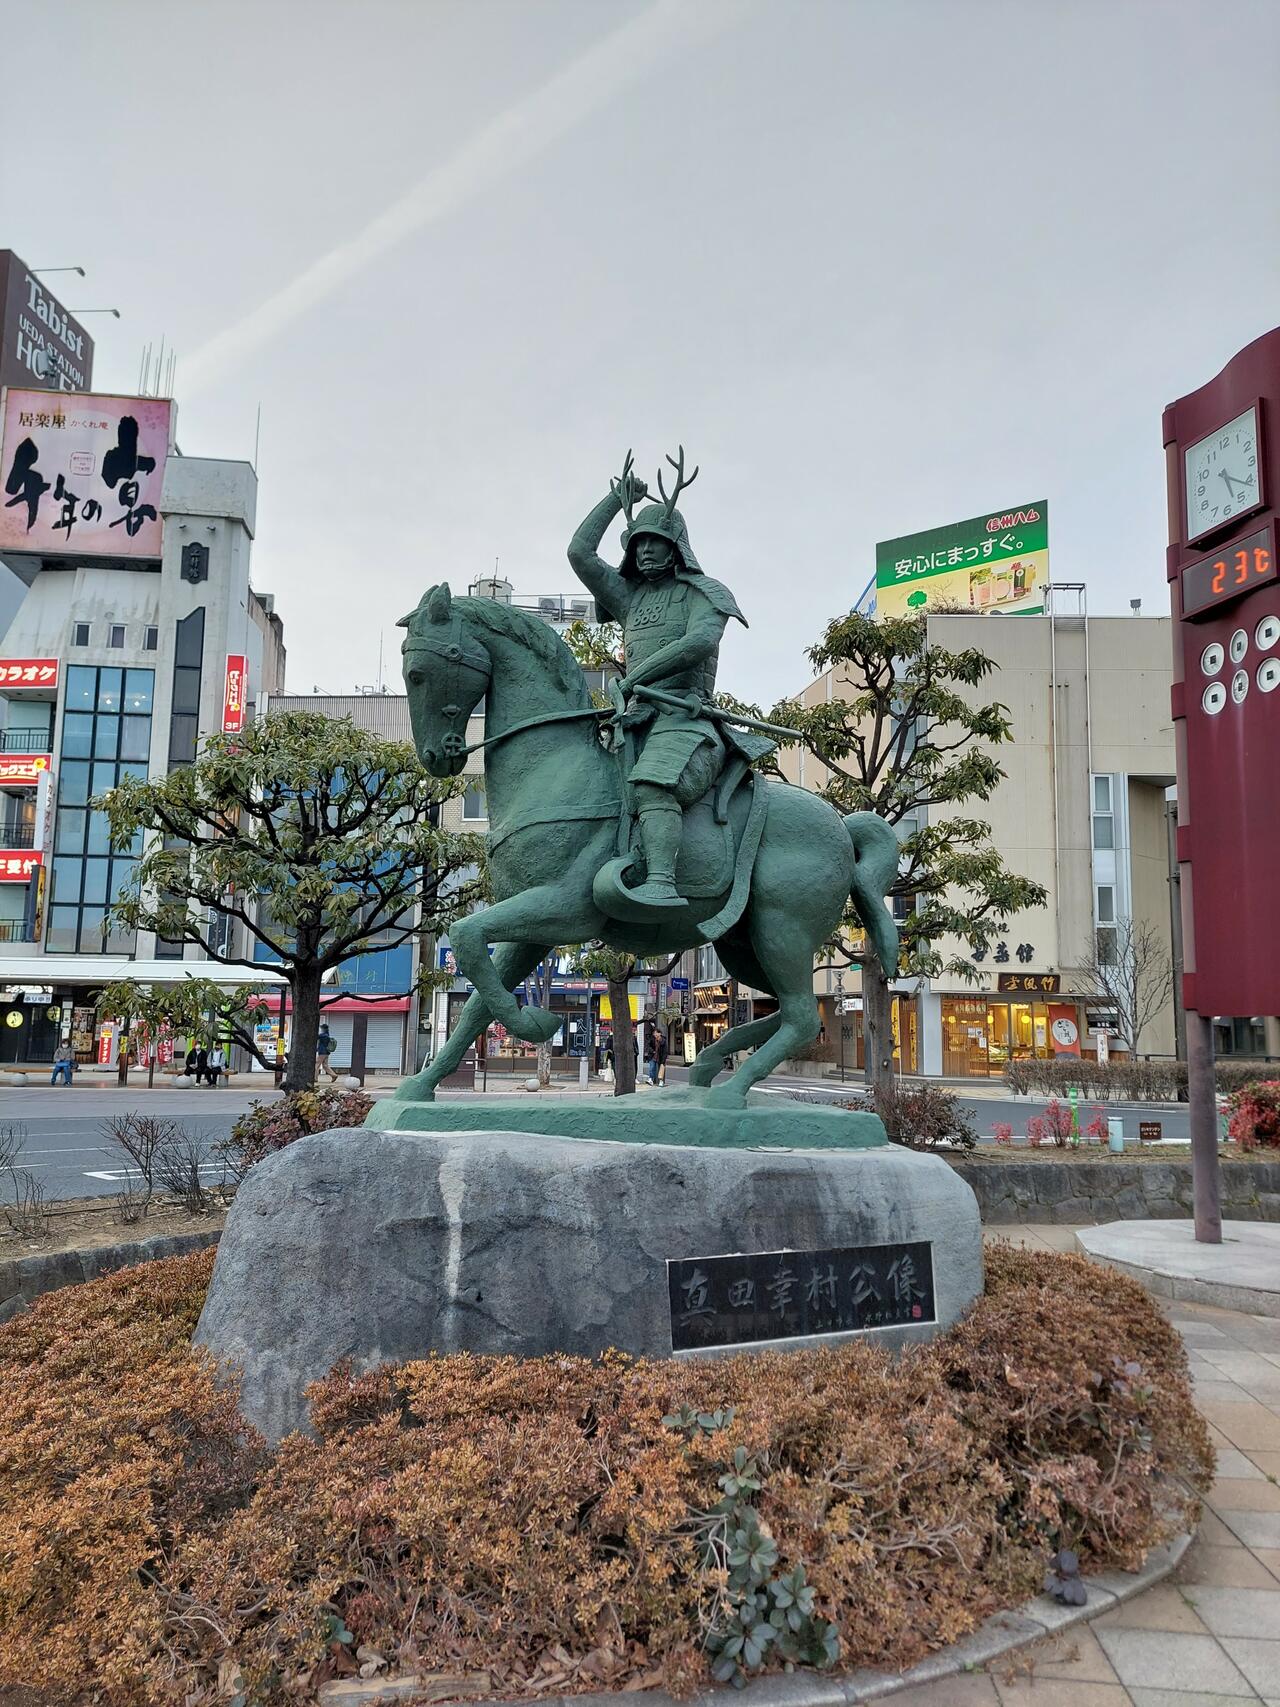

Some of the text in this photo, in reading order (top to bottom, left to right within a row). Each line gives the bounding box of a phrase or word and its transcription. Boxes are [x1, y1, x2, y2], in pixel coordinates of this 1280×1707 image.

[25, 273, 84, 361] Tabist
[19, 313, 84, 387] UEDA STATION
[16, 331, 76, 391] HOE
[18, 411, 66, 430] 居楽屋
[1218, 437, 1231, 451] 12
[1235, 433, 1240, 445] 1
[1243, 440, 1252, 453] 2
[1206, 450, 1218, 465] 11
[1247, 455, 1256, 468] 3
[1197, 469, 1210, 483] 10
[1196, 486, 1206, 497] 9
[1236, 492, 1246, 504] 5
[1200, 499, 1209, 511] 8
[1211, 506, 1219, 518] 7
[1223, 504, 1232, 516] 6
[985, 510, 1039, 532] 信州ハム
[894, 533, 1024, 579] 安心にまっすぐ。
[225, 722, 239, 730] 3F
[101, 1037, 110, 1064] カラオケ
[680, 1253, 927, 1327] 真田幸村公像
